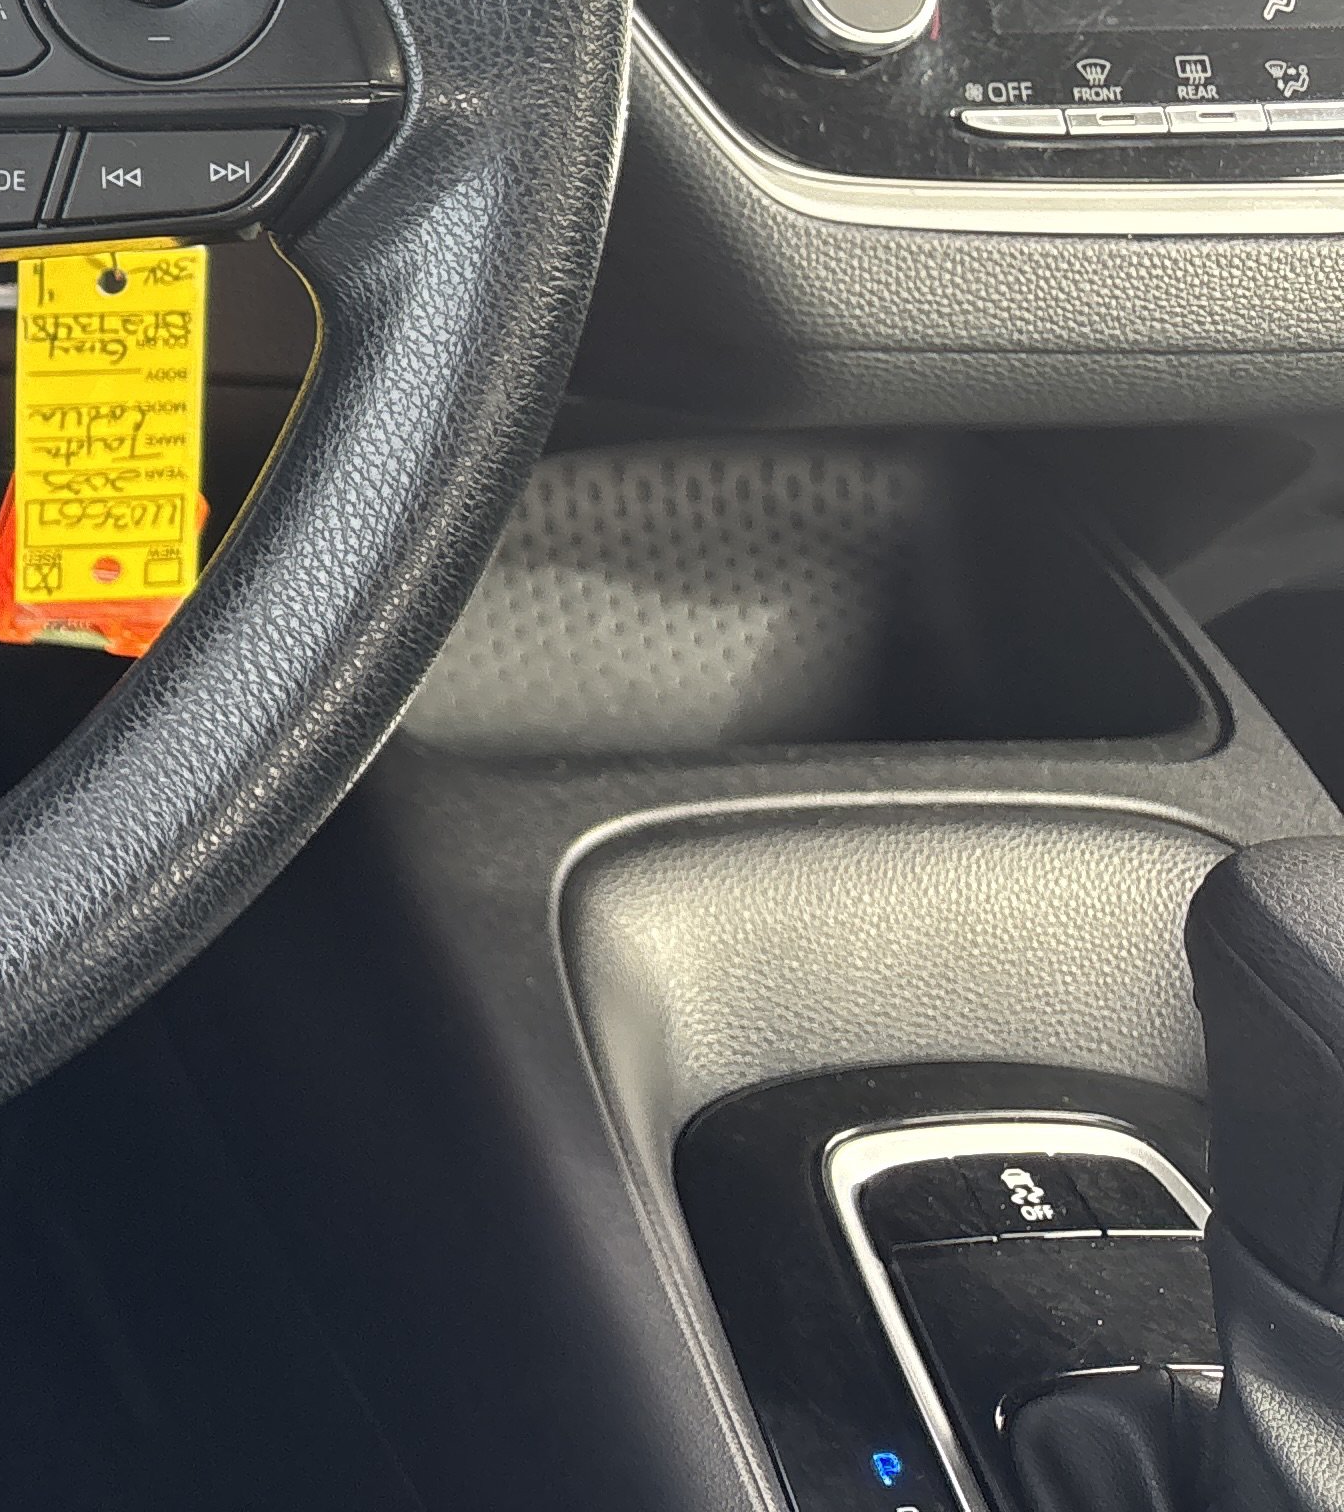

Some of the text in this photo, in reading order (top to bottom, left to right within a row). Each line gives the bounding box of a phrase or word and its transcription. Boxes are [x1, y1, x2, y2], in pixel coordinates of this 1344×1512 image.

[988, 81, 1033, 103] OFF
[1072, 85, 1123, 103] FRONT
[1176, 84, 1219, 101] REAR
[145, 367, 189, 381] BODY
[144, 433, 187, 448] MAKE
[144, 467, 189, 482] YEAR
[1019, 1204, 1055, 1222] OFF
[872, 1451, 902, 1487] P
